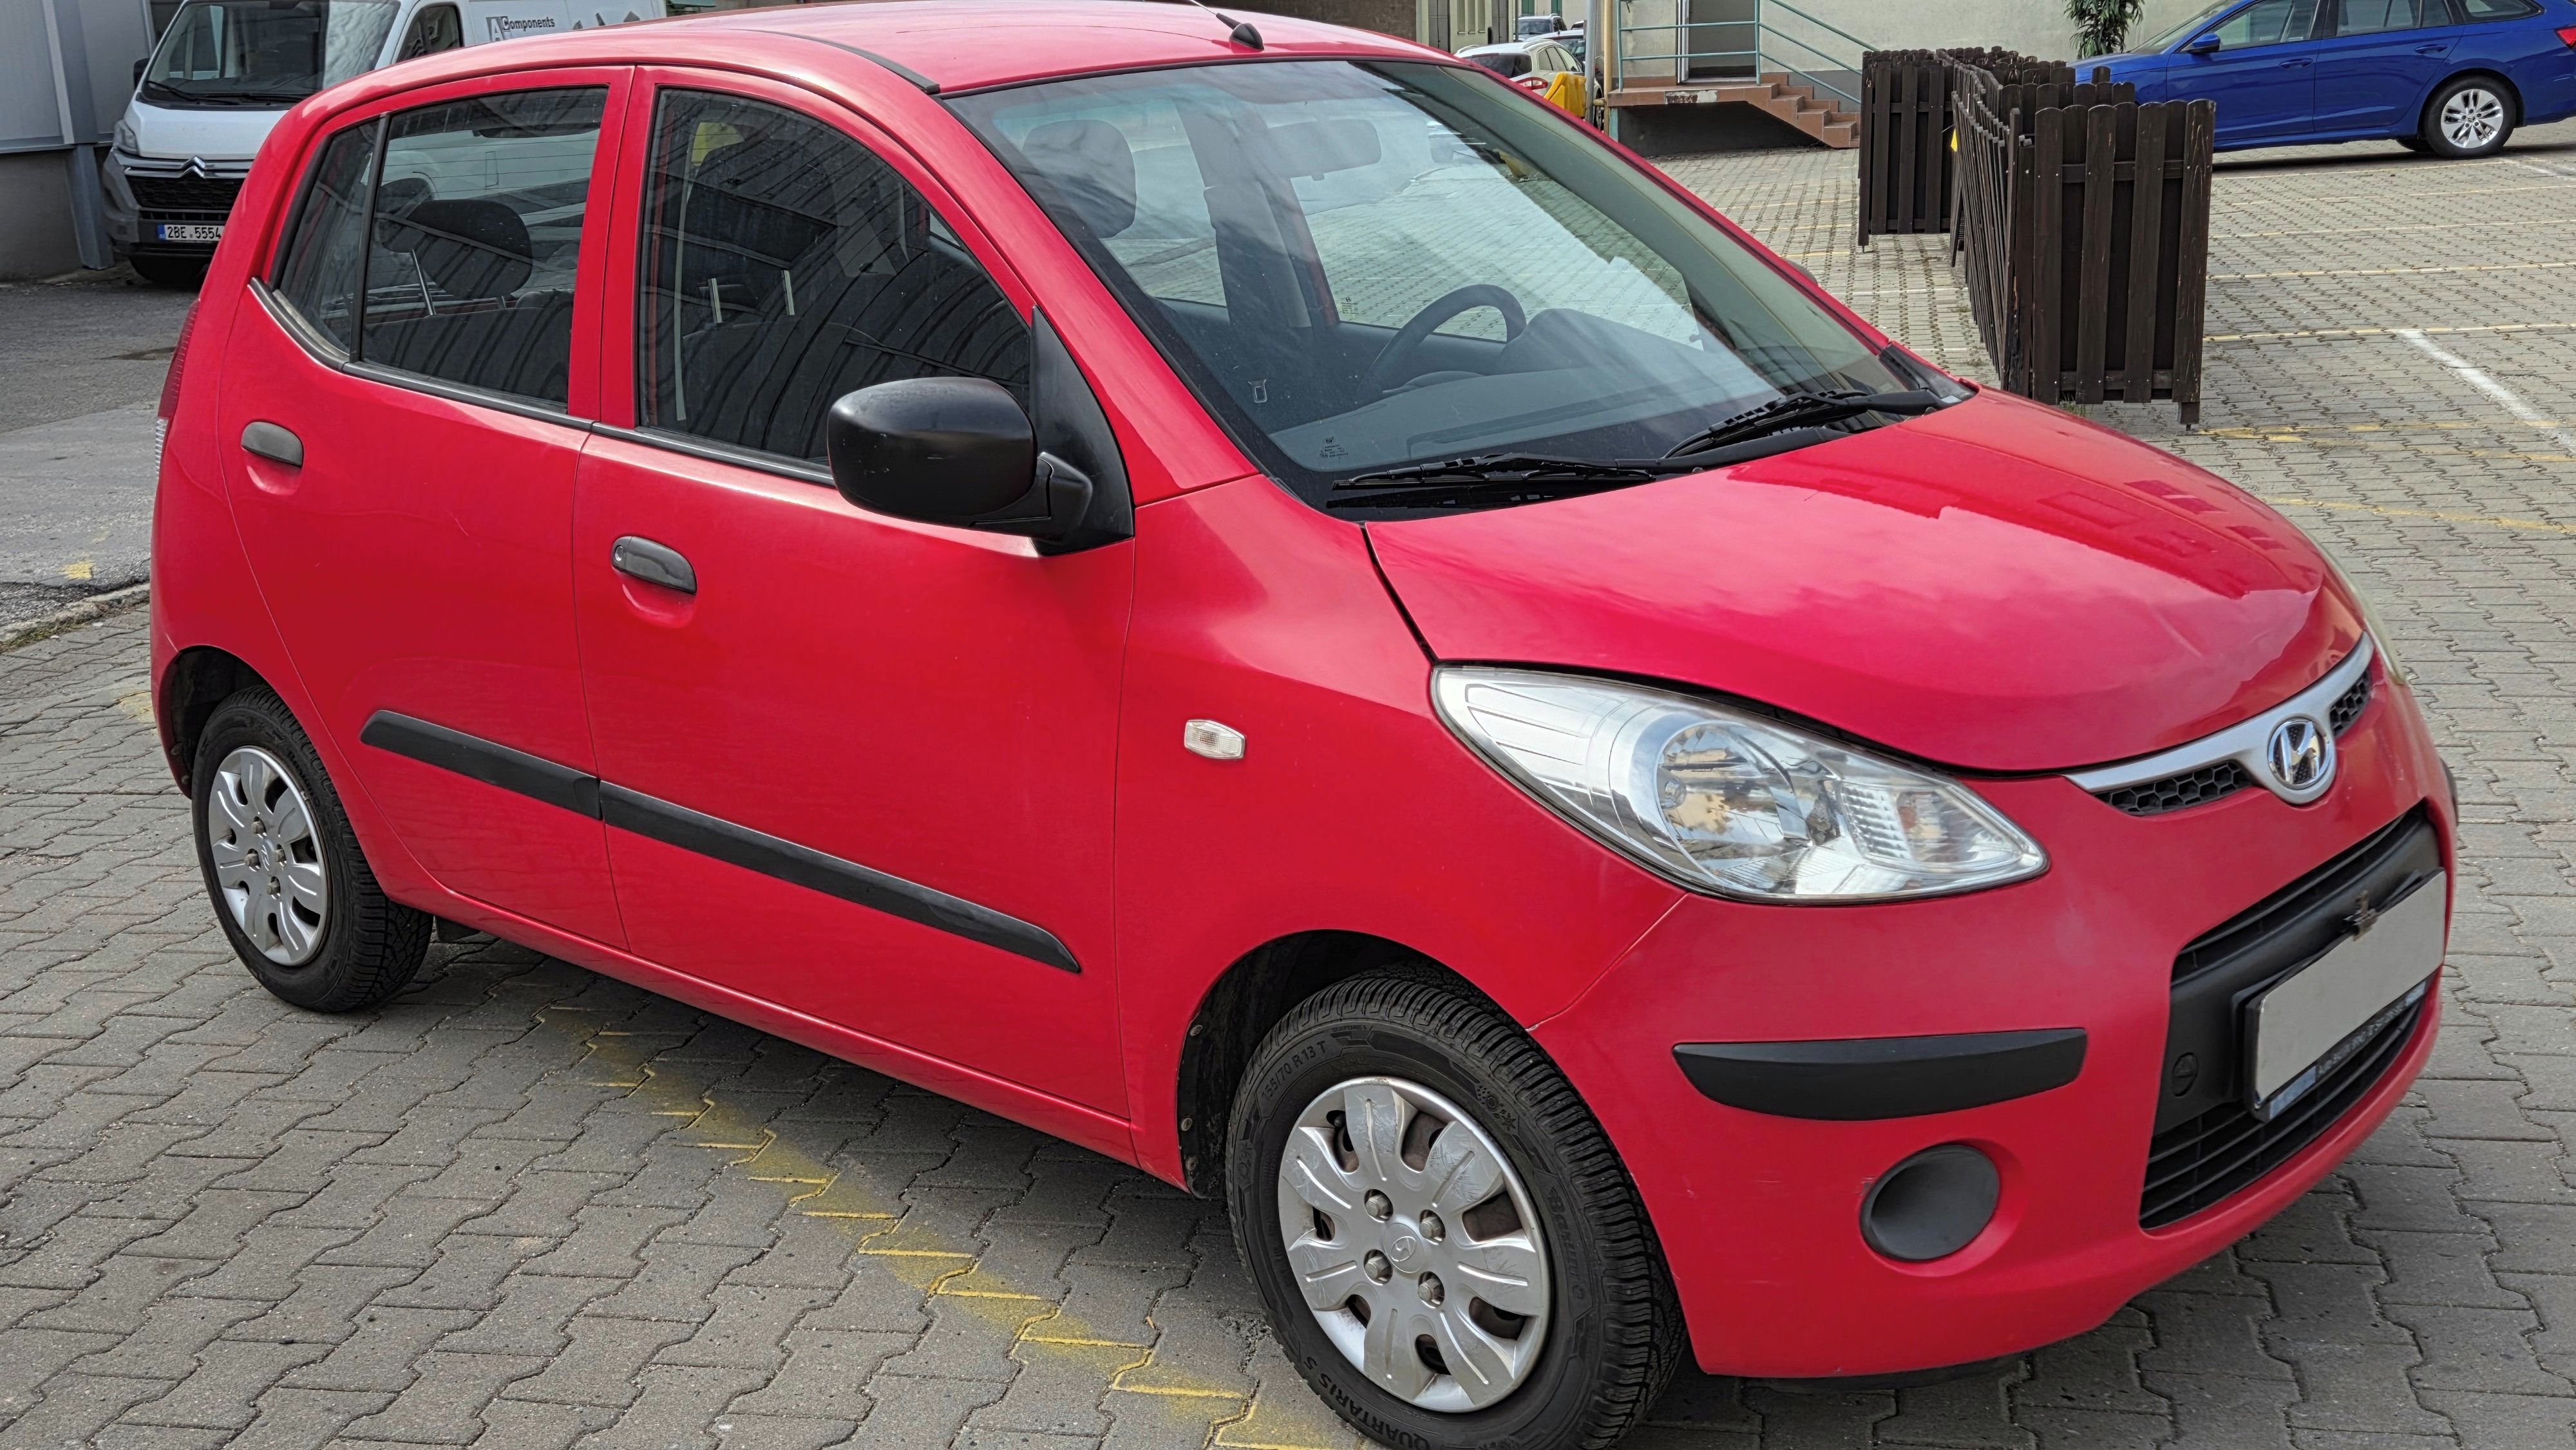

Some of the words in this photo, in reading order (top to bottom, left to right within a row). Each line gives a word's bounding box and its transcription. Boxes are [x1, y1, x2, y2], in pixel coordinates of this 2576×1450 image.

[502, 16, 555, 32] Components
[167, 226, 187, 238] 2BE
[1317, 1373, 1431, 1450] QUARTARIS
